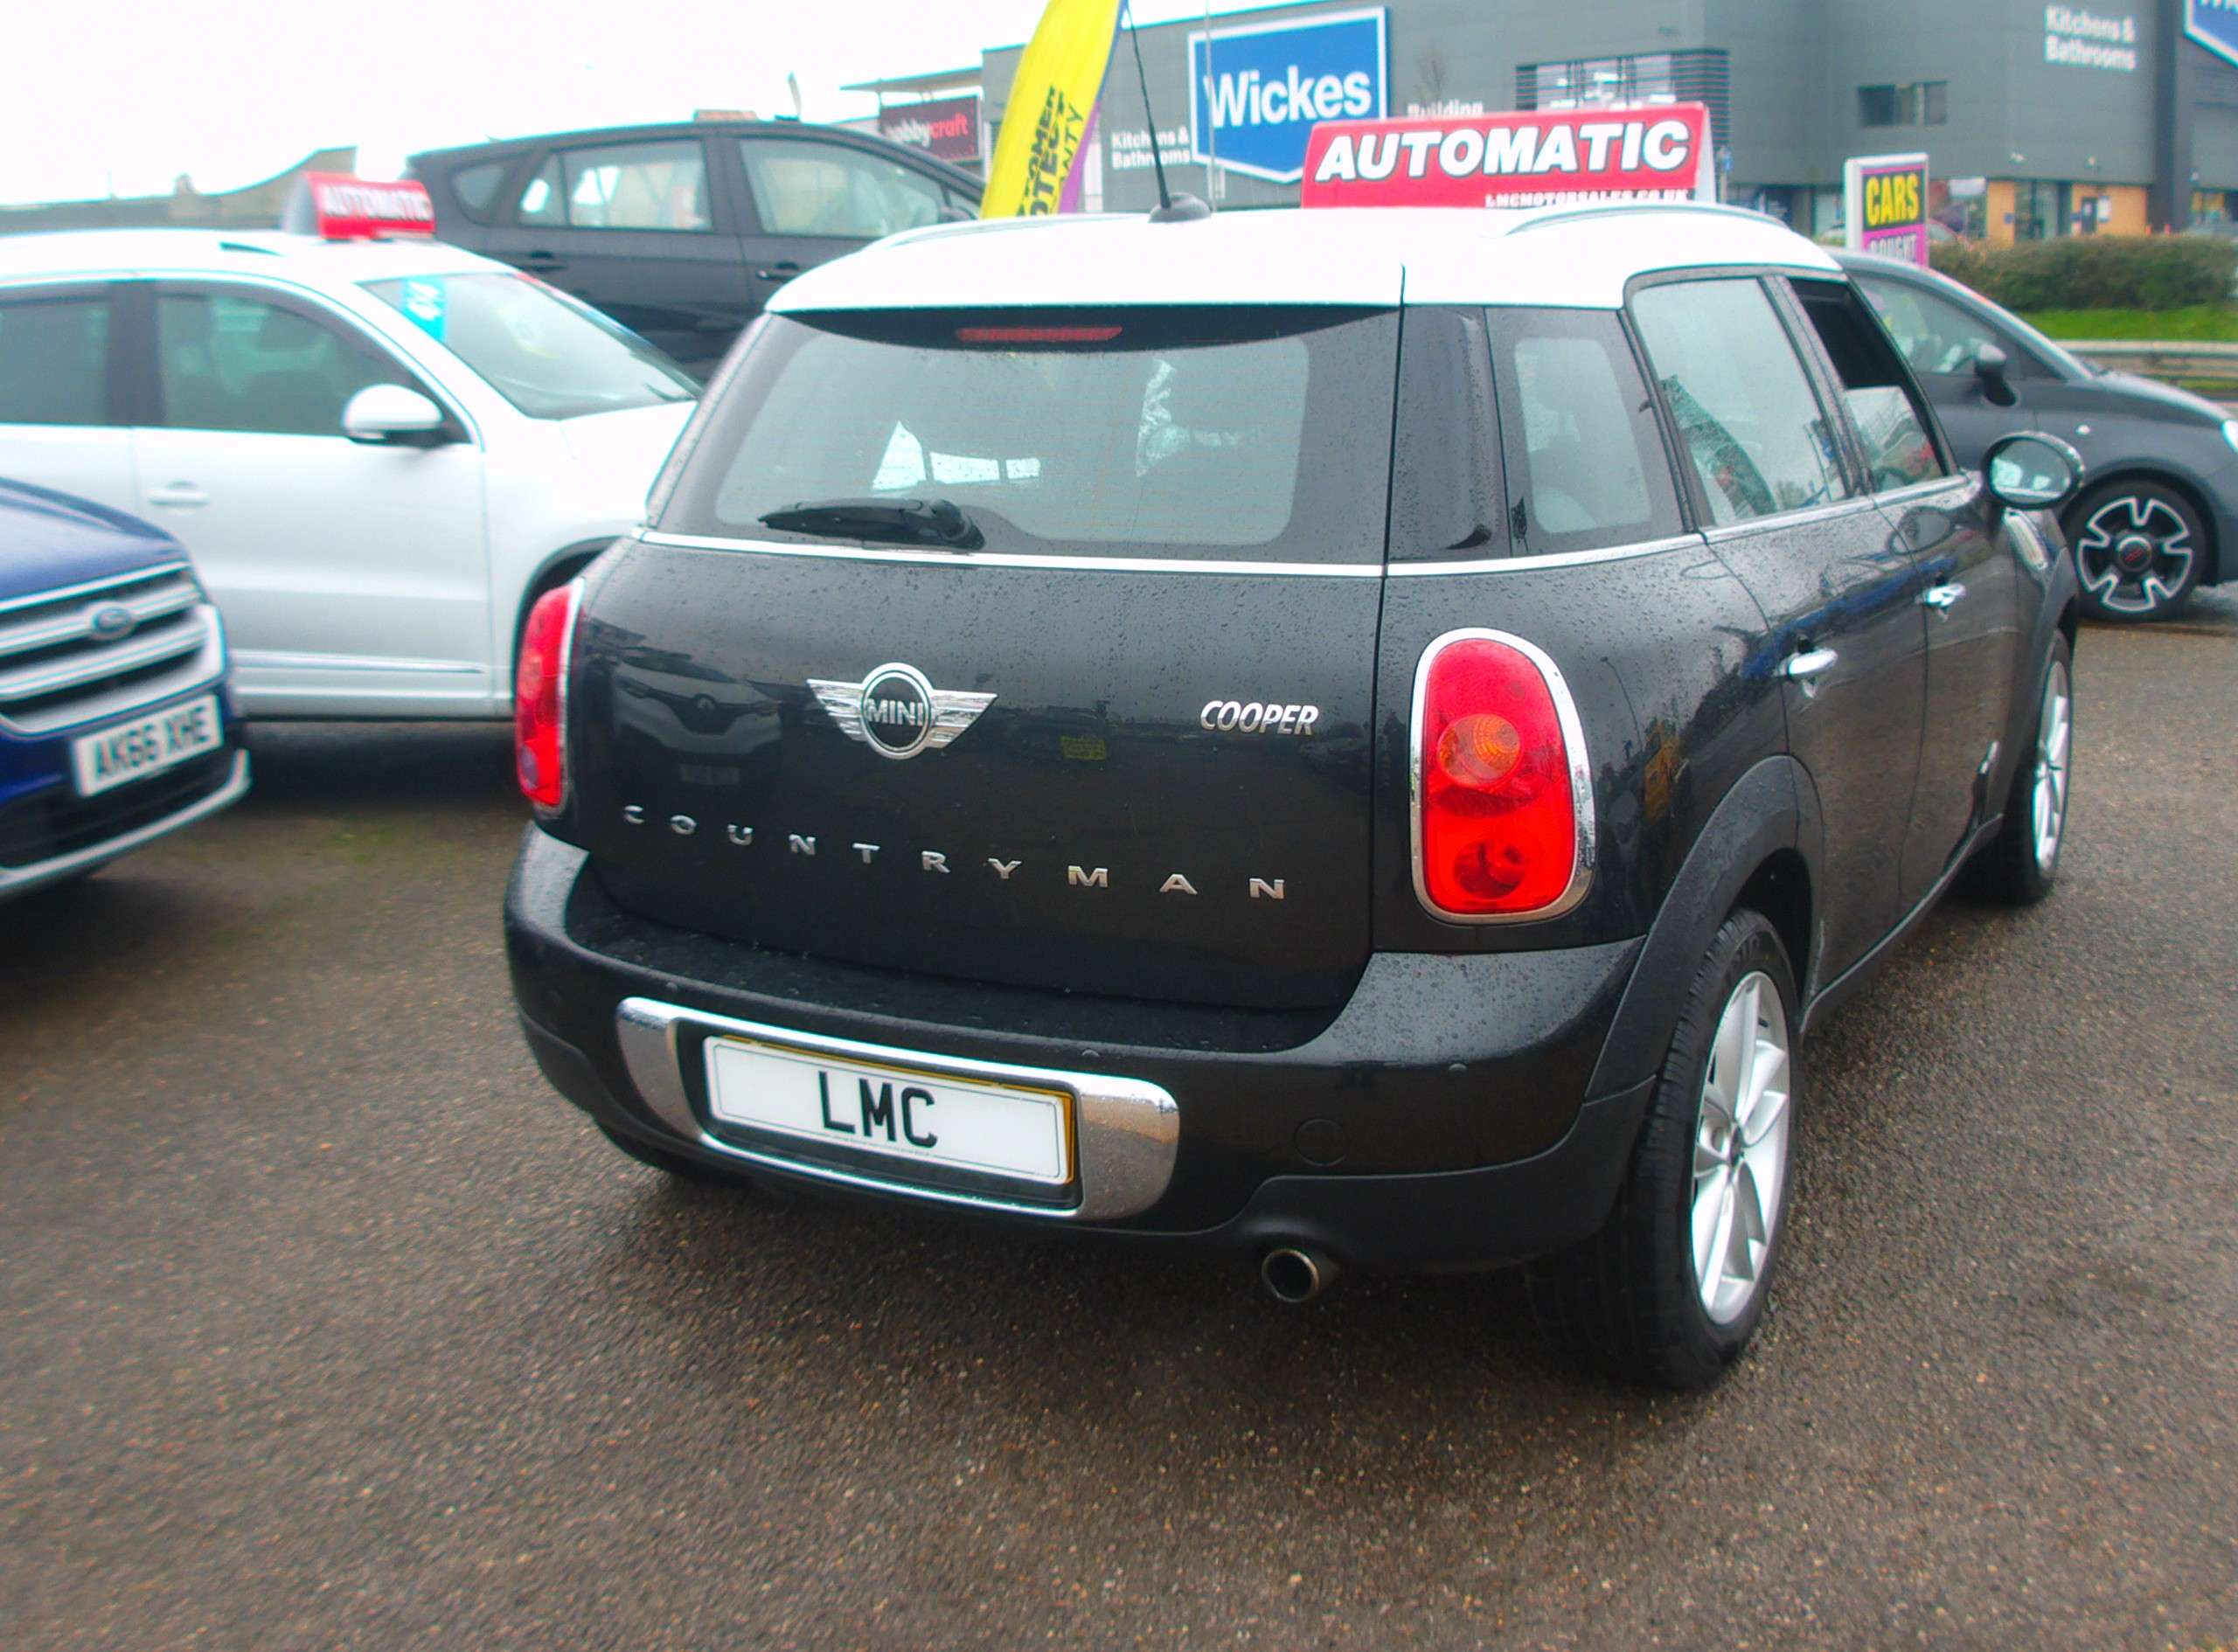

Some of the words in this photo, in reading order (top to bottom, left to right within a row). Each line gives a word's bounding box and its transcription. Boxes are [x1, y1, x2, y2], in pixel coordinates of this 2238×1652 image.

[2045, 6, 2120, 41] Kitchens
[2123, 16, 2135, 42] &
[2045, 35, 2137, 71] Bathrooms
[1203, 65, 1372, 128] Wickes
[1112, 129, 1175, 149] Kitchns
[1177, 125, 1189, 145] &
[1315, 121, 1690, 181] AUTOMATIC
[1112, 149, 1190, 170] Bathroms
[1866, 172, 1920, 226] CARS
[866, 698, 924, 727] MINI
[1199, 700, 1319, 735] COOPER
[622, 803, 1285, 900] COUNTRYMAN
[818, 1070, 938, 1149] LMC
